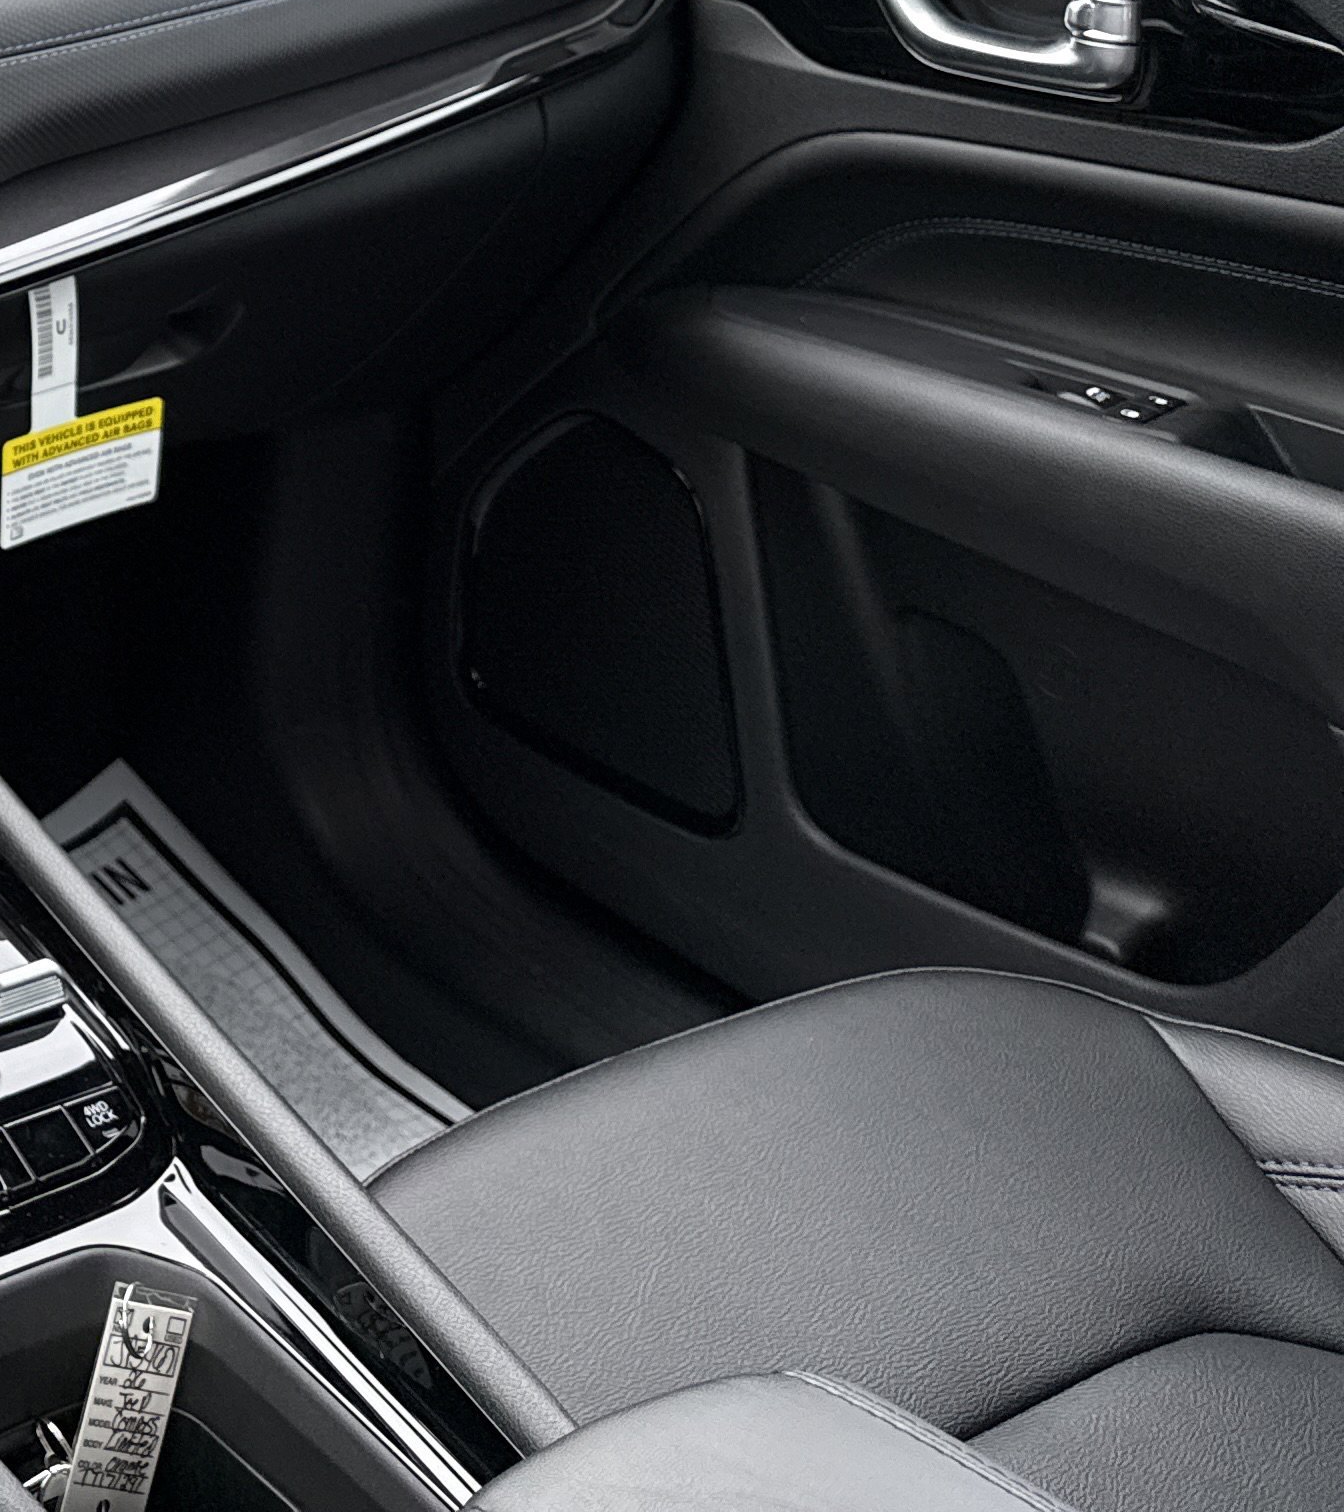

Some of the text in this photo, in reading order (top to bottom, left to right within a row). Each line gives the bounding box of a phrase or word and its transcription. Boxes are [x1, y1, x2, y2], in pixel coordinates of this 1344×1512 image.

[13, 405, 154, 457] THIS VEHICLE IS EQUIPPED
[13, 418, 153, 468] WITH ADVANCED AIR BAGS
[83, 1100, 109, 1116] 4WD
[85, 1109, 120, 1128] LOCK
[99, 1375, 118, 1386] YEAR
